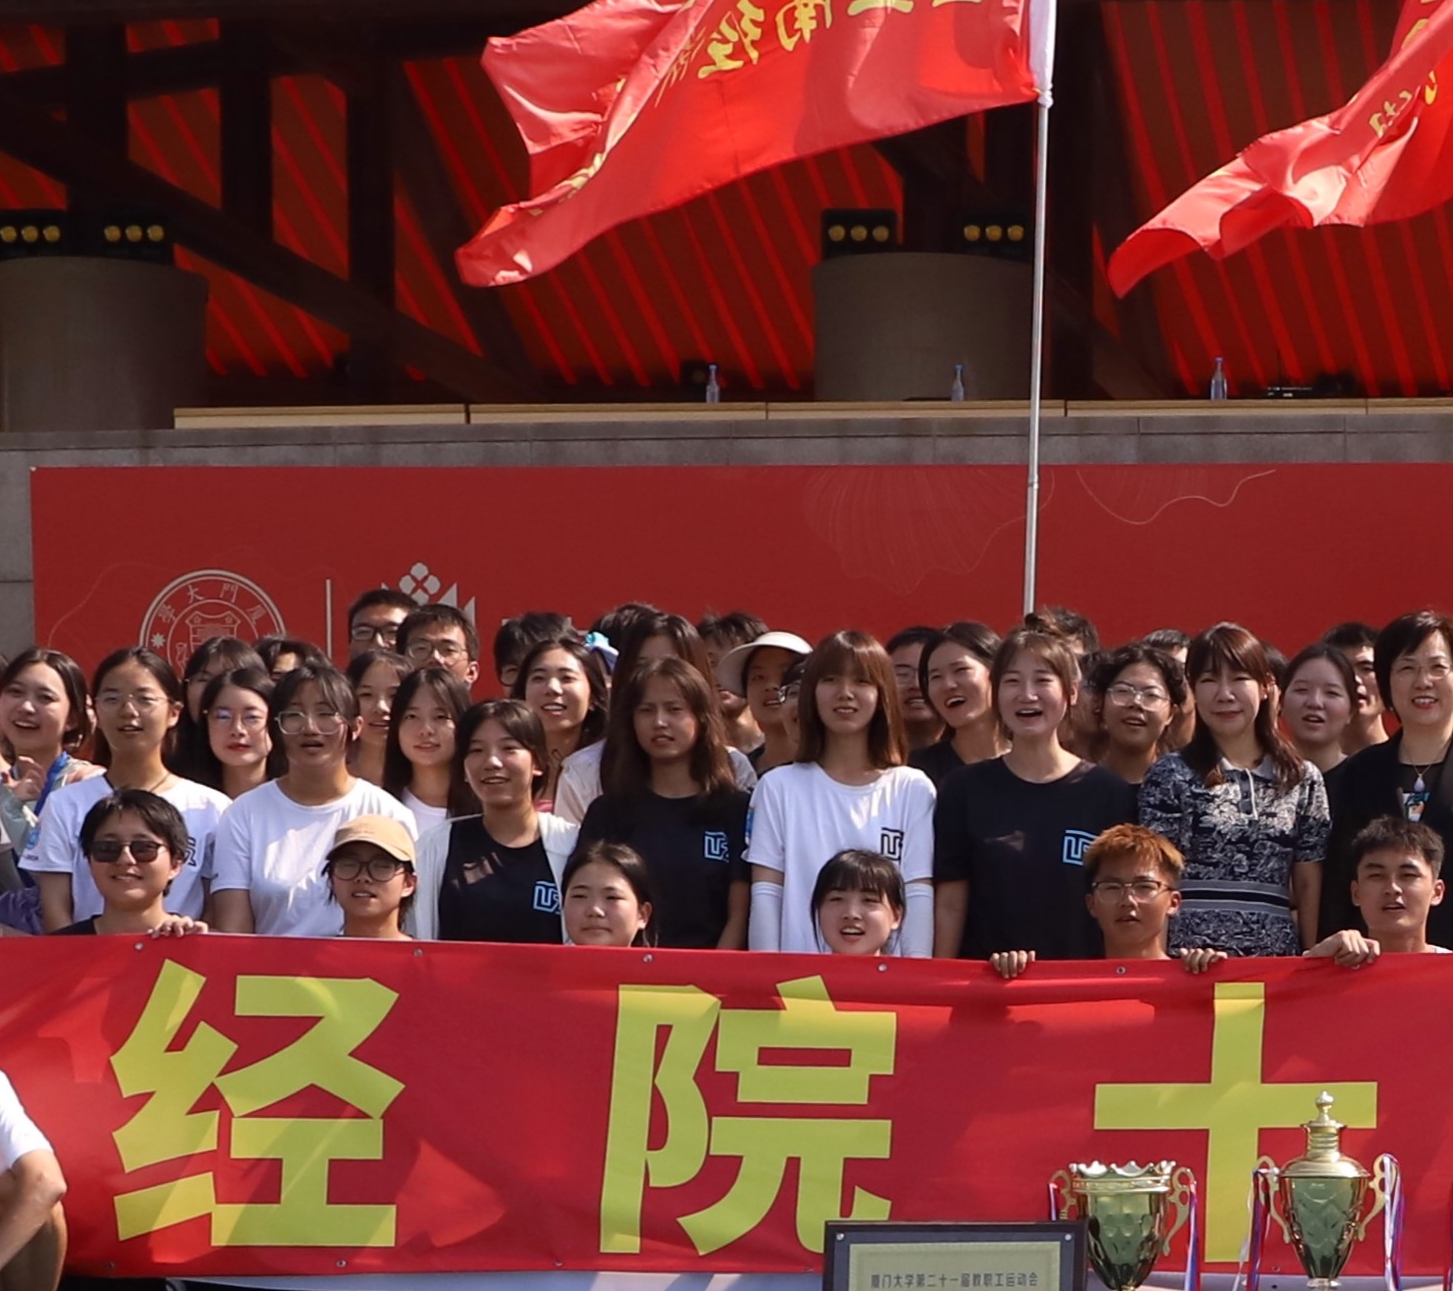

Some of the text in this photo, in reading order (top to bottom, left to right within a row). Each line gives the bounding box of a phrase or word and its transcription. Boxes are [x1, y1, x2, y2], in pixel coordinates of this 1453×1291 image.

[870, 1271, 1039, 1290] 厦门大学第二十一届教职工运动会
